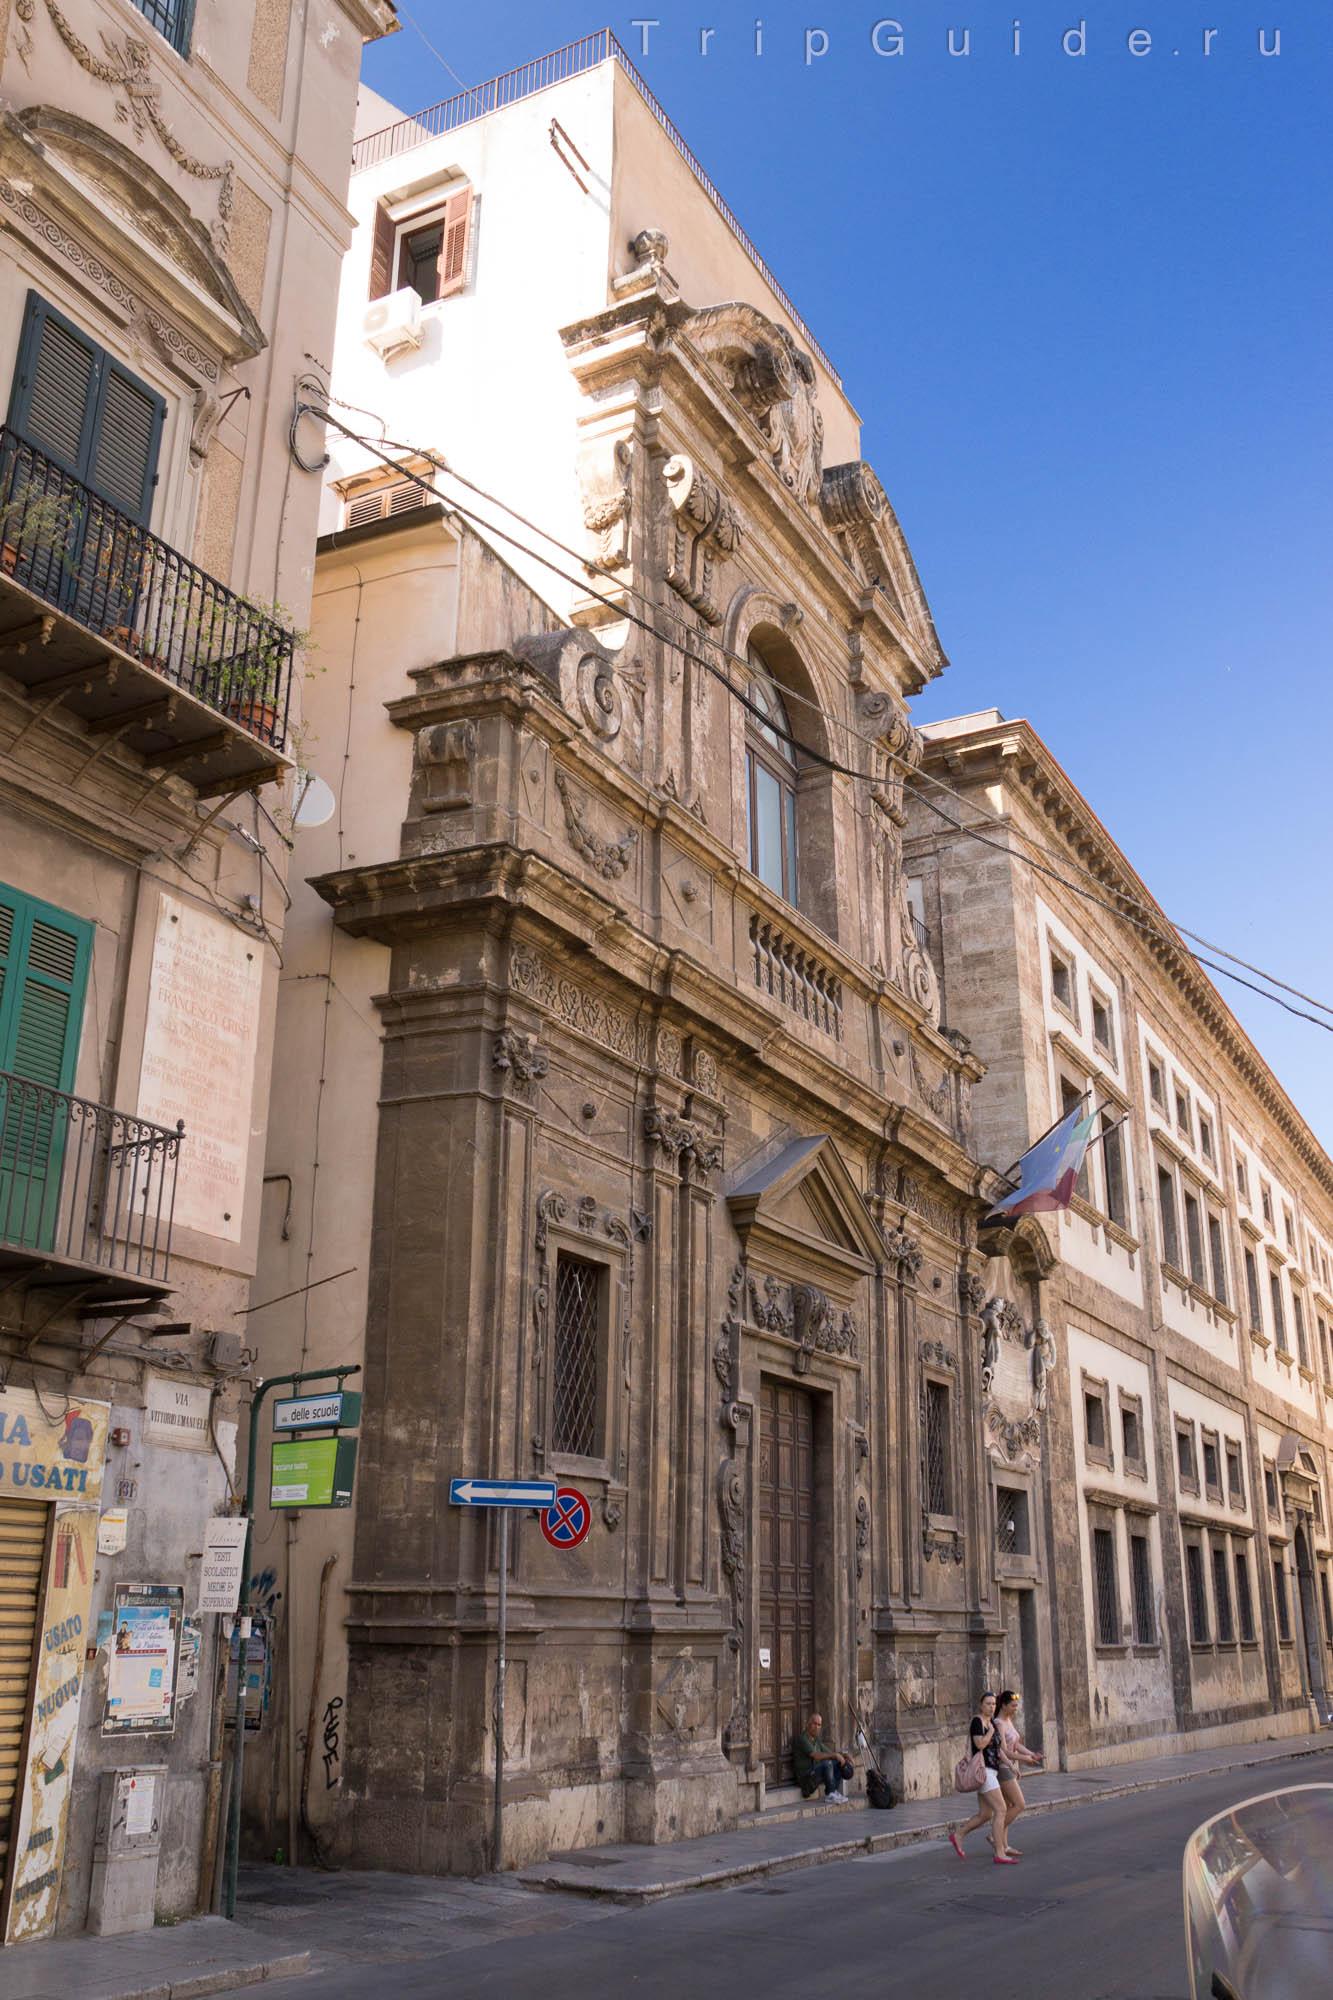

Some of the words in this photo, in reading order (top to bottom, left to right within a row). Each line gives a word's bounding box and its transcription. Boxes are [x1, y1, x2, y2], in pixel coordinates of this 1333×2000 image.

[175, 1392, 189, 1407] VIA
[151, 1409, 177, 1425] VITTORIO
[177, 1414, 208, 1431] EMANUELE
[290, 1407, 310, 1422] delle
[312, 1403, 339, 1419] scuole
[12, 1461, 88, 1492] USATI
[213, 1551, 231, 1562] TESTI
[203, 1566, 238, 1577] SCOLASTICI
[201, 1597, 233, 1608] SUPERIORI
[44, 1613, 82, 1652] USATO
[37, 1675, 80, 1723] NUOVO
